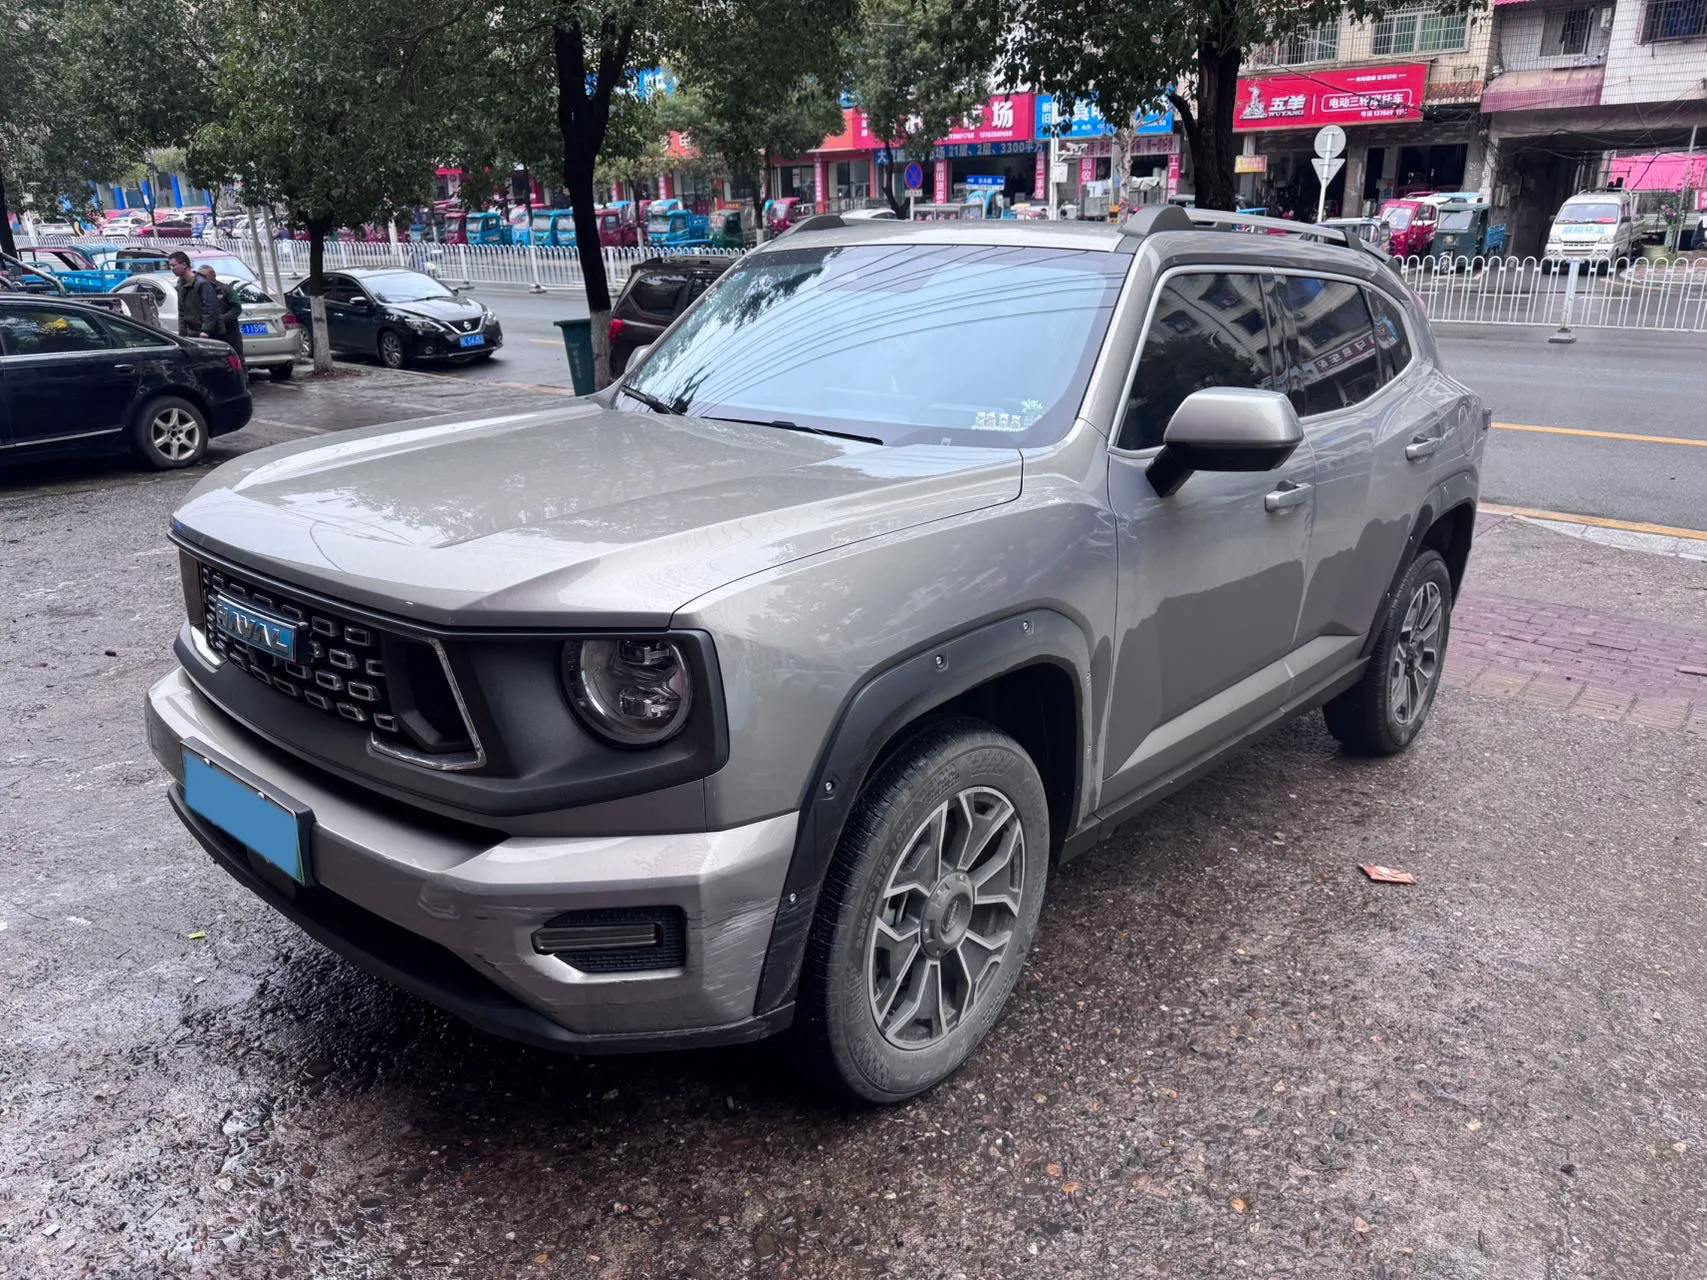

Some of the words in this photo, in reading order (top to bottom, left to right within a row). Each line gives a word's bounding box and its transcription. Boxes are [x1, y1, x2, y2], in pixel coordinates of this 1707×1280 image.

[1268, 94, 1306, 111] 五羊
[1267, 109, 1305, 118] WUYANG
[216, 603, 289, 654] HAVAL
